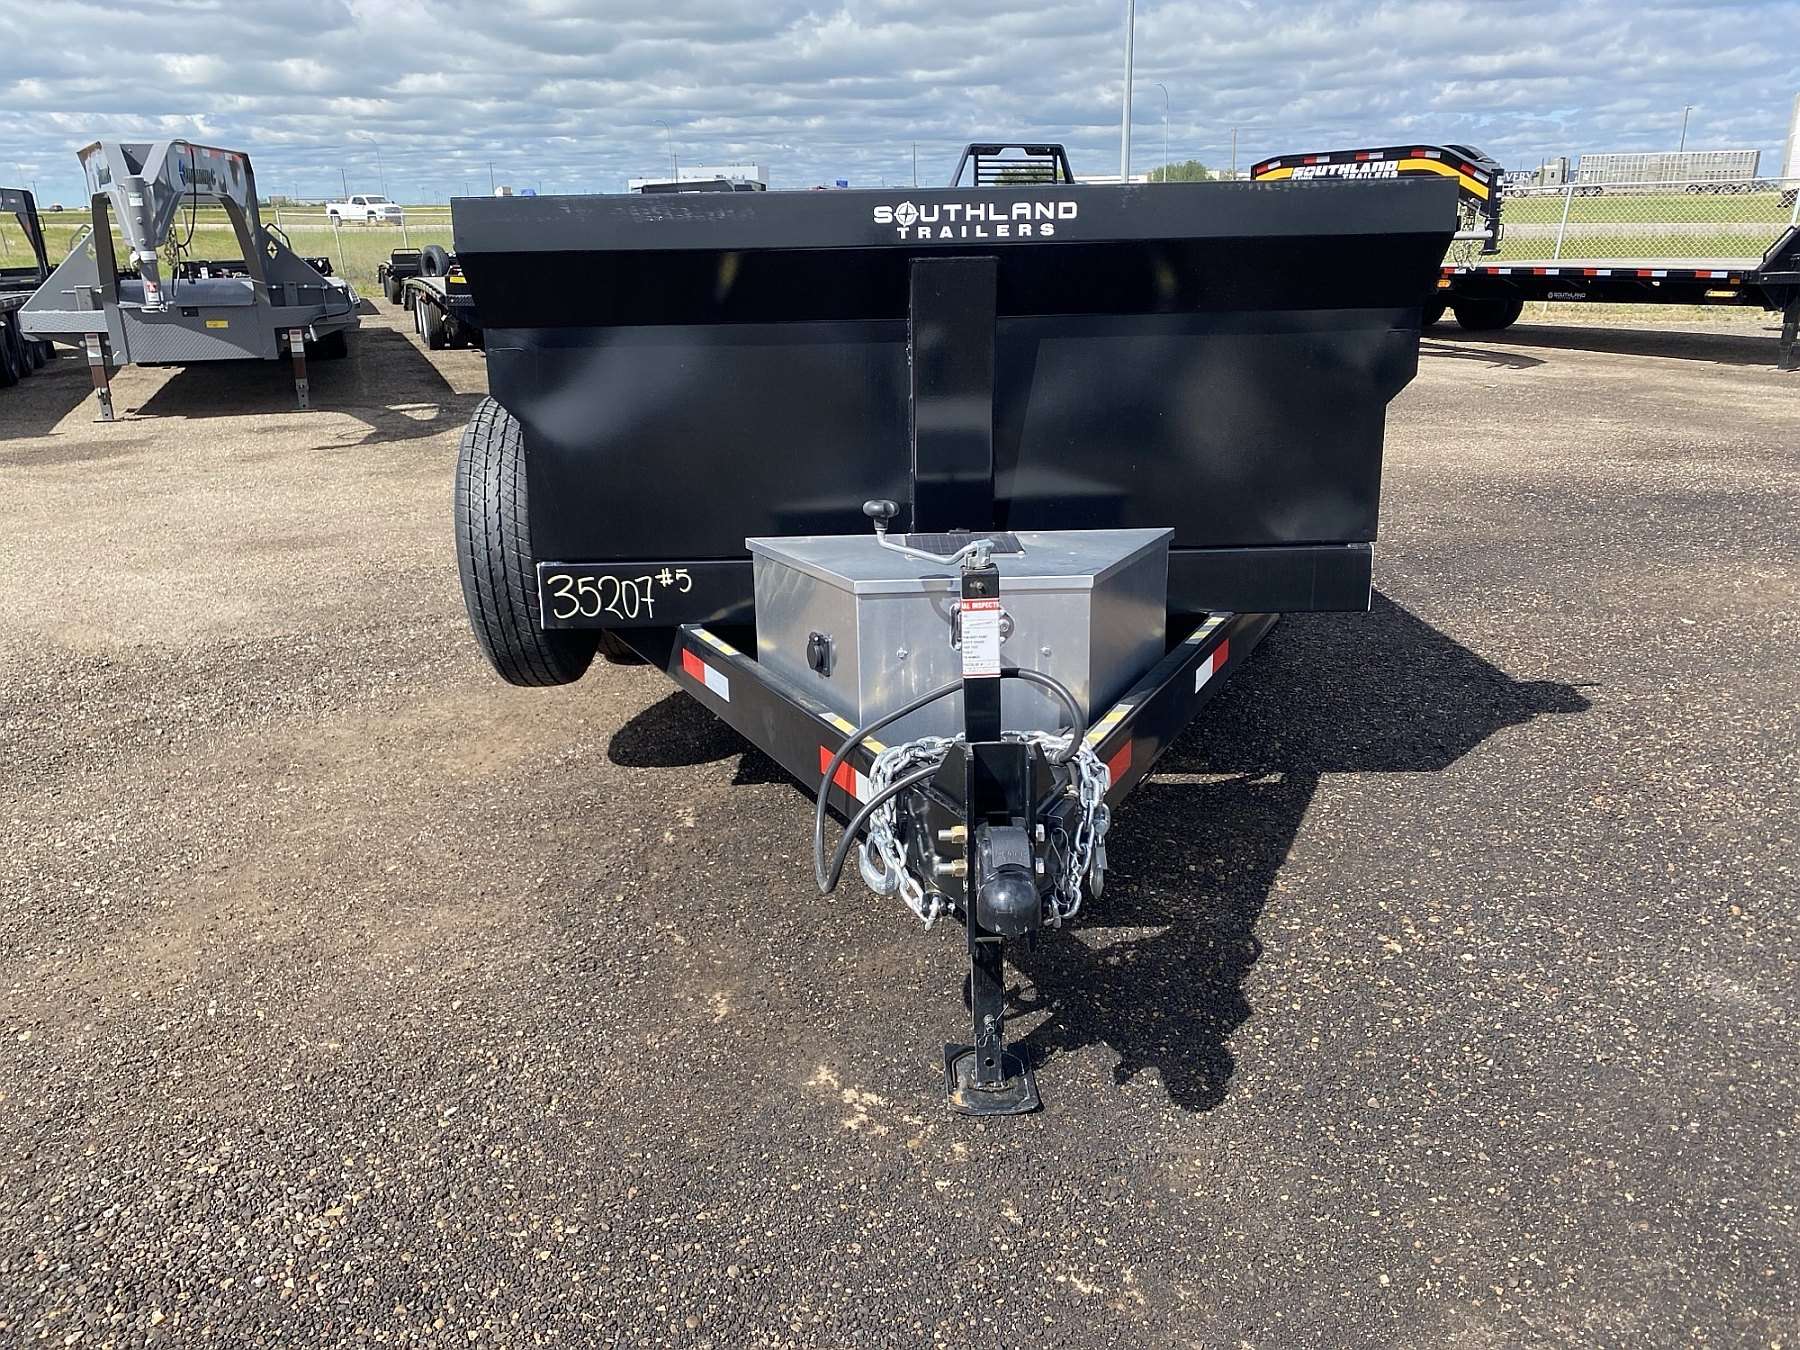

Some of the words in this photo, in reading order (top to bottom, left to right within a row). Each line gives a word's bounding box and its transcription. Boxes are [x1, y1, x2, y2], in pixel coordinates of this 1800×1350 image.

[1292, 160, 1399, 175] SOUTHLAND
[1342, 170, 1398, 179] TRAILERS
[873, 201, 1078, 225] SOUTHLAND
[897, 223, 1056, 239] TRAILERS
[547, 574, 655, 620] 35207
[654, 568, 692, 593] #5
